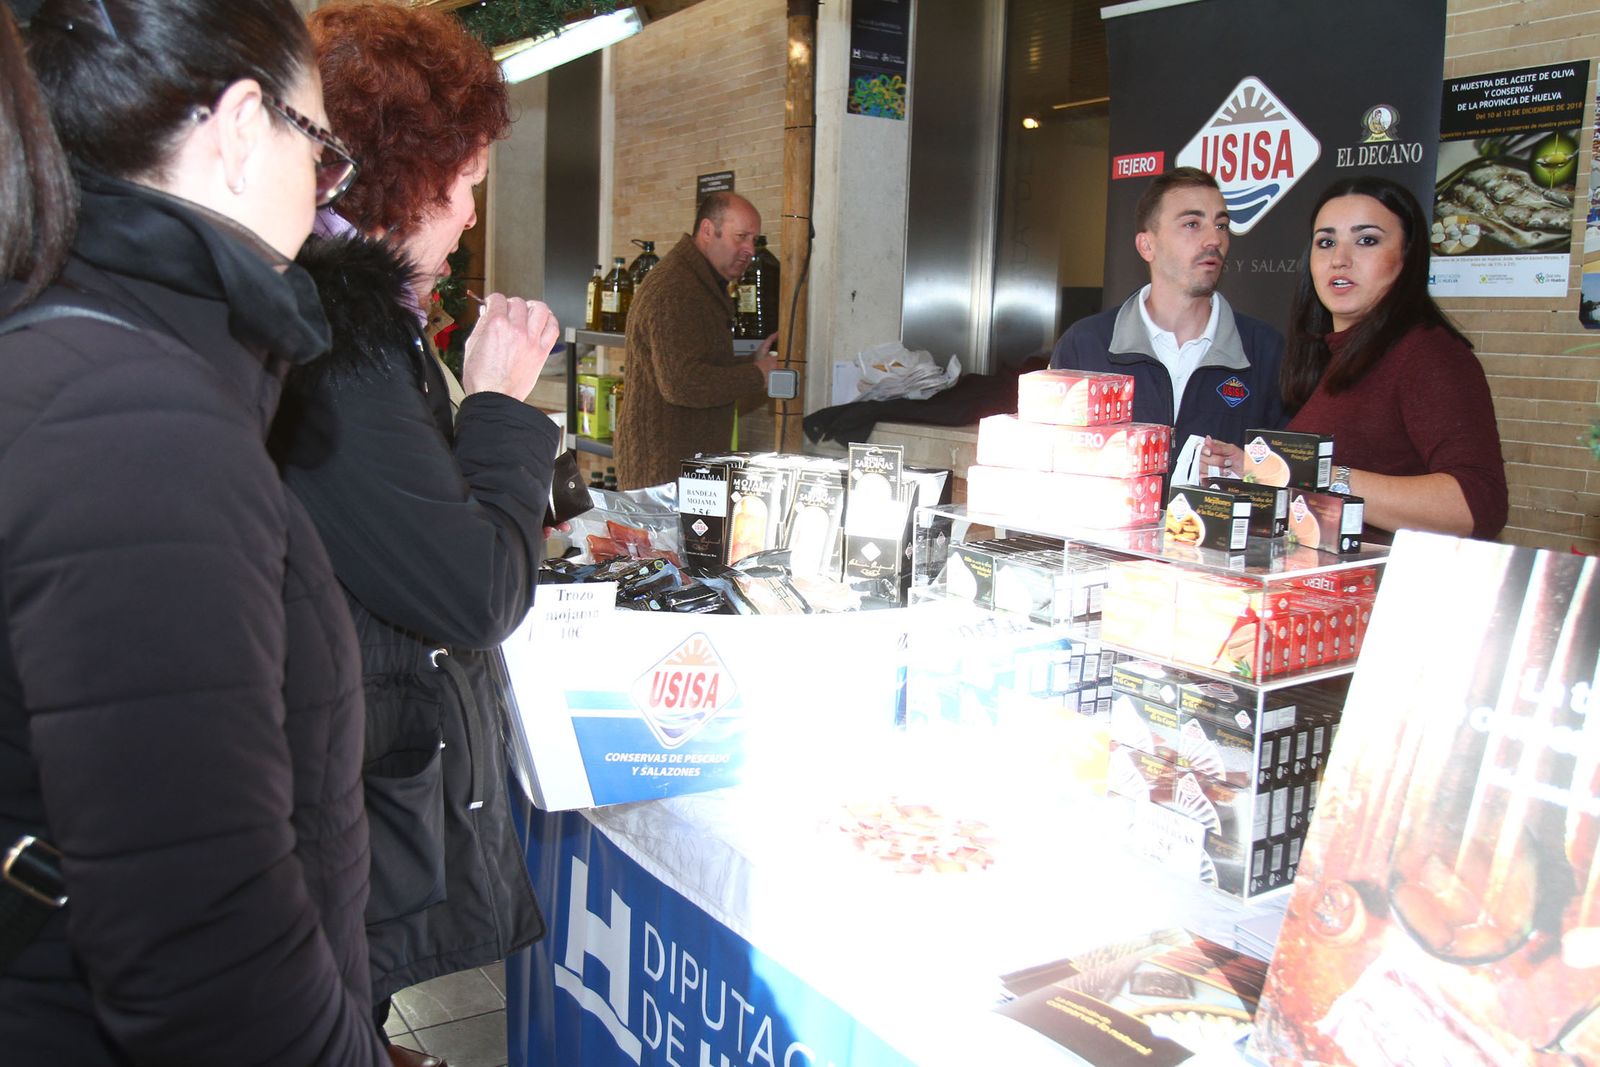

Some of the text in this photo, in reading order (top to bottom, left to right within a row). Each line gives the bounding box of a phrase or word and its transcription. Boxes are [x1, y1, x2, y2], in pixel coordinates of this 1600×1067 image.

[1452, 68, 1575, 92] IX MUESTRA DEL ACEITE DE OLIVA
[1484, 85, 1534, 98] Y CONSERVAS
[1457, 92, 1562, 112] DE LA PROVINCIA DE HUELVA
[1475, 112, 1485, 120] Del
[1512, 108, 1520, 116] DE
[1522, 104, 1554, 116] DICIEMBRE
[1555, 104, 1565, 112] DE
[1201, 129, 1294, 183] USISA
[1336, 143, 1423, 168] EL DECANO
[1117, 156, 1156, 174] TEJERO
[1236, 260, 1244, 272] Y
[1223, 385, 1246, 398] USISA
[855, 460, 894, 470] SARDINAS
[683, 472, 720, 481] MOJAMA
[686, 489, 717, 498] BANDEJA
[687, 498, 716, 506] MOJAMA
[1302, 578, 1336, 592] TEJERO
[556, 589, 594, 602] Trozo
[649, 671, 720, 709] USISA
[604, 752, 730, 764] CONSERVAS DE PESCADO
[632, 766, 701, 777] Y SALAZONES
[642, 990, 685, 1067] DE
